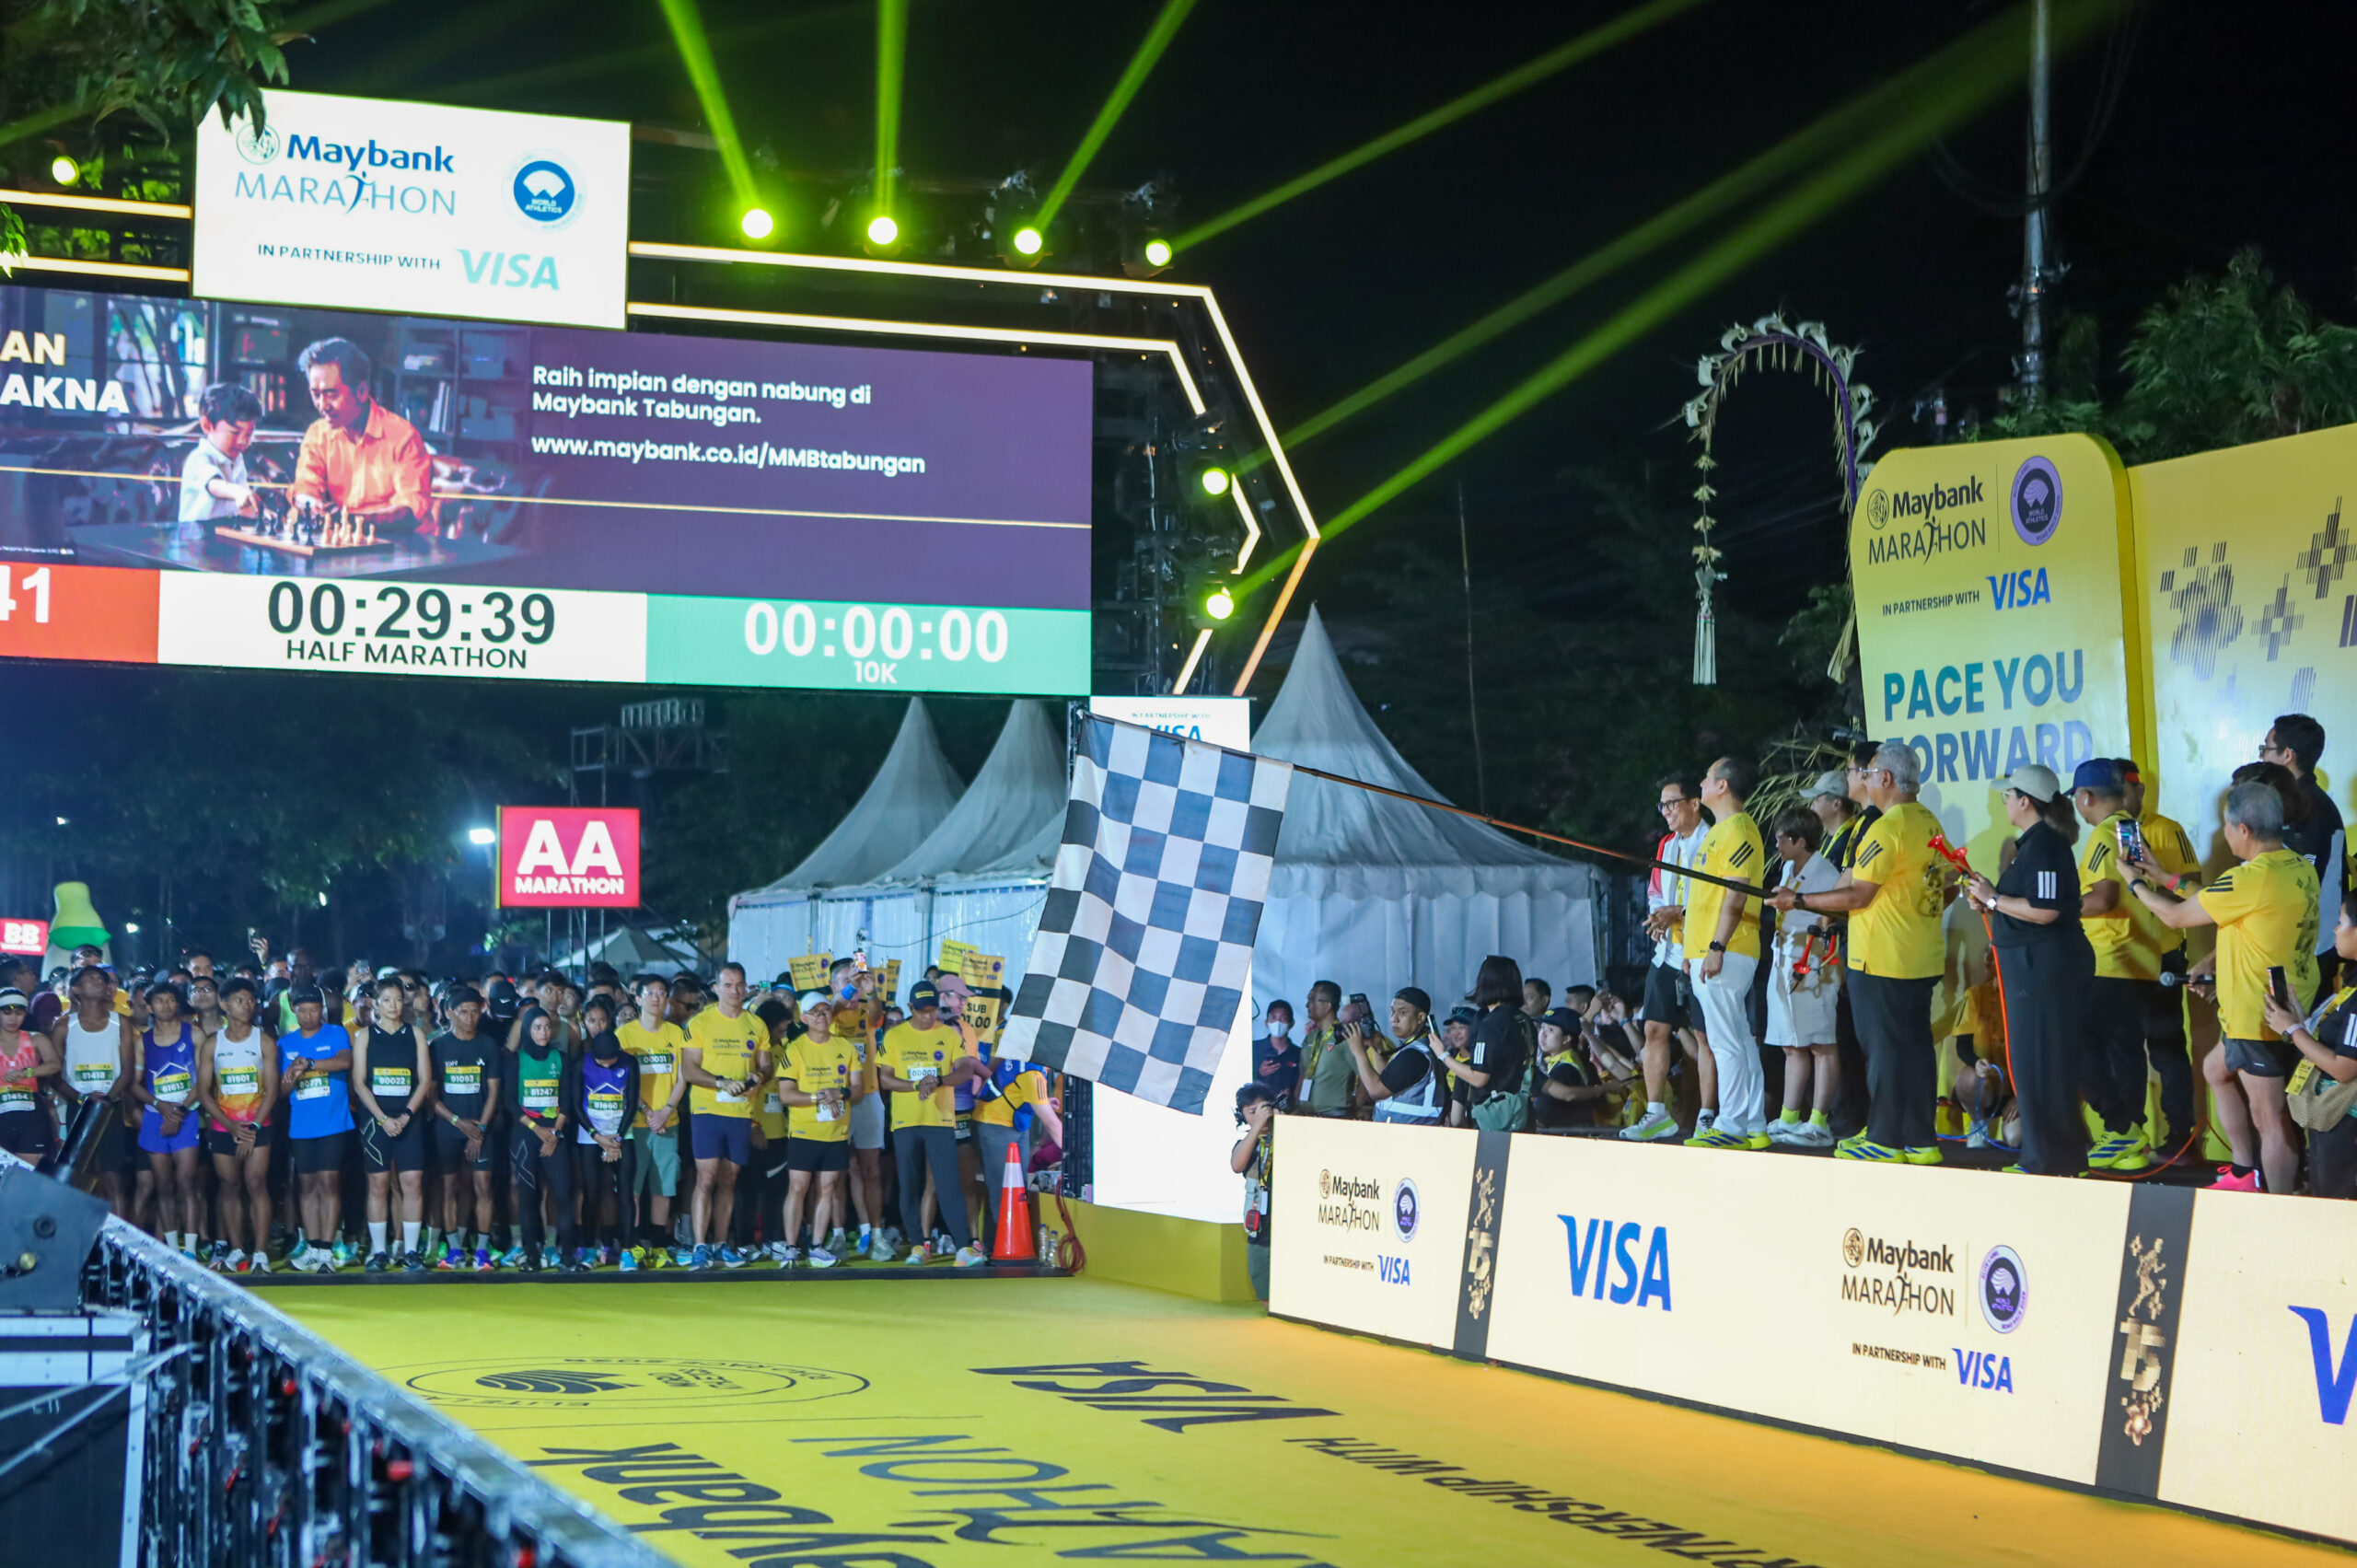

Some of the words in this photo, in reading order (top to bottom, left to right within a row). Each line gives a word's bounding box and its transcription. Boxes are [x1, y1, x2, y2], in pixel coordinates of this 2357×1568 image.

[286, 134, 455, 174] Maybank
[235, 171, 456, 215] MARATHON
[525, 203, 563, 215] ATHLETICS
[258, 243, 274, 259] IN
[279, 245, 393, 267] PARTNERSHIP
[398, 255, 441, 271] WITH
[456, 248, 560, 292] VISA
[0, 329, 66, 367] AN
[0, 373, 131, 414] AKNA
[532, 365, 583, 389] Raih
[587, 367, 667, 398] impian
[671, 371, 757, 401] dengan
[761, 378, 846, 409] nabung
[850, 383, 871, 406] di
[532, 390, 638, 419] Maybank
[643, 398, 762, 426] Tabungan.
[531, 435, 926, 478] www.maybank.co.id/MMBtabungan
[1892, 475, 1984, 519] Maybank
[1868, 516, 1986, 566] MARATHON
[267, 580, 555, 645] 00:29:39
[1882, 604, 1892, 617] IN
[1893, 593, 1954, 615] PARTNERSHIP
[1955, 589, 1980, 606] WITH
[1984, 566, 2051, 611] VISA
[744, 601, 1009, 663] 00:00:00
[286, 639, 356, 664] HALF
[364, 642, 528, 670] MARATHON
[853, 660, 898, 686] 10K
[1883, 661, 1985, 722] PACE
[1992, 648, 2084, 711] YOU
[1886, 719, 2094, 785] ORWARD
[516, 819, 624, 877] AA
[514, 876, 625, 895] MARATHON
[4, 922, 41, 945] BB
[966, 1002, 988, 1014] SUB
[1331, 1175, 1380, 1202] Maybank
[1318, 1202, 1380, 1233] MARATHON
[1323, 1254, 1329, 1265] IN
[1329, 1255, 1361, 1270] PARTNERSHIP
[1361, 1260, 1375, 1272] WITH
[1376, 1254, 1411, 1286] VISA
[1556, 1214, 1672, 1312] VISA
[1866, 1237, 1954, 1274] Maybank
[1841, 1272, 1954, 1317] MARATHON
[1852, 1342, 1861, 1356] IN
[1863, 1344, 1922, 1366] PARTNERSHIP
[1922, 1355, 1946, 1371] WITH
[1951, 1347, 2014, 1395] VISA
[967, 1360, 1345, 1434] VISA
[1282, 1436, 1468, 1475] WITH
[788, 1436, 1341, 1568] ATHON
[1422, 1476, 1826, 1568] RTNERSHIP
